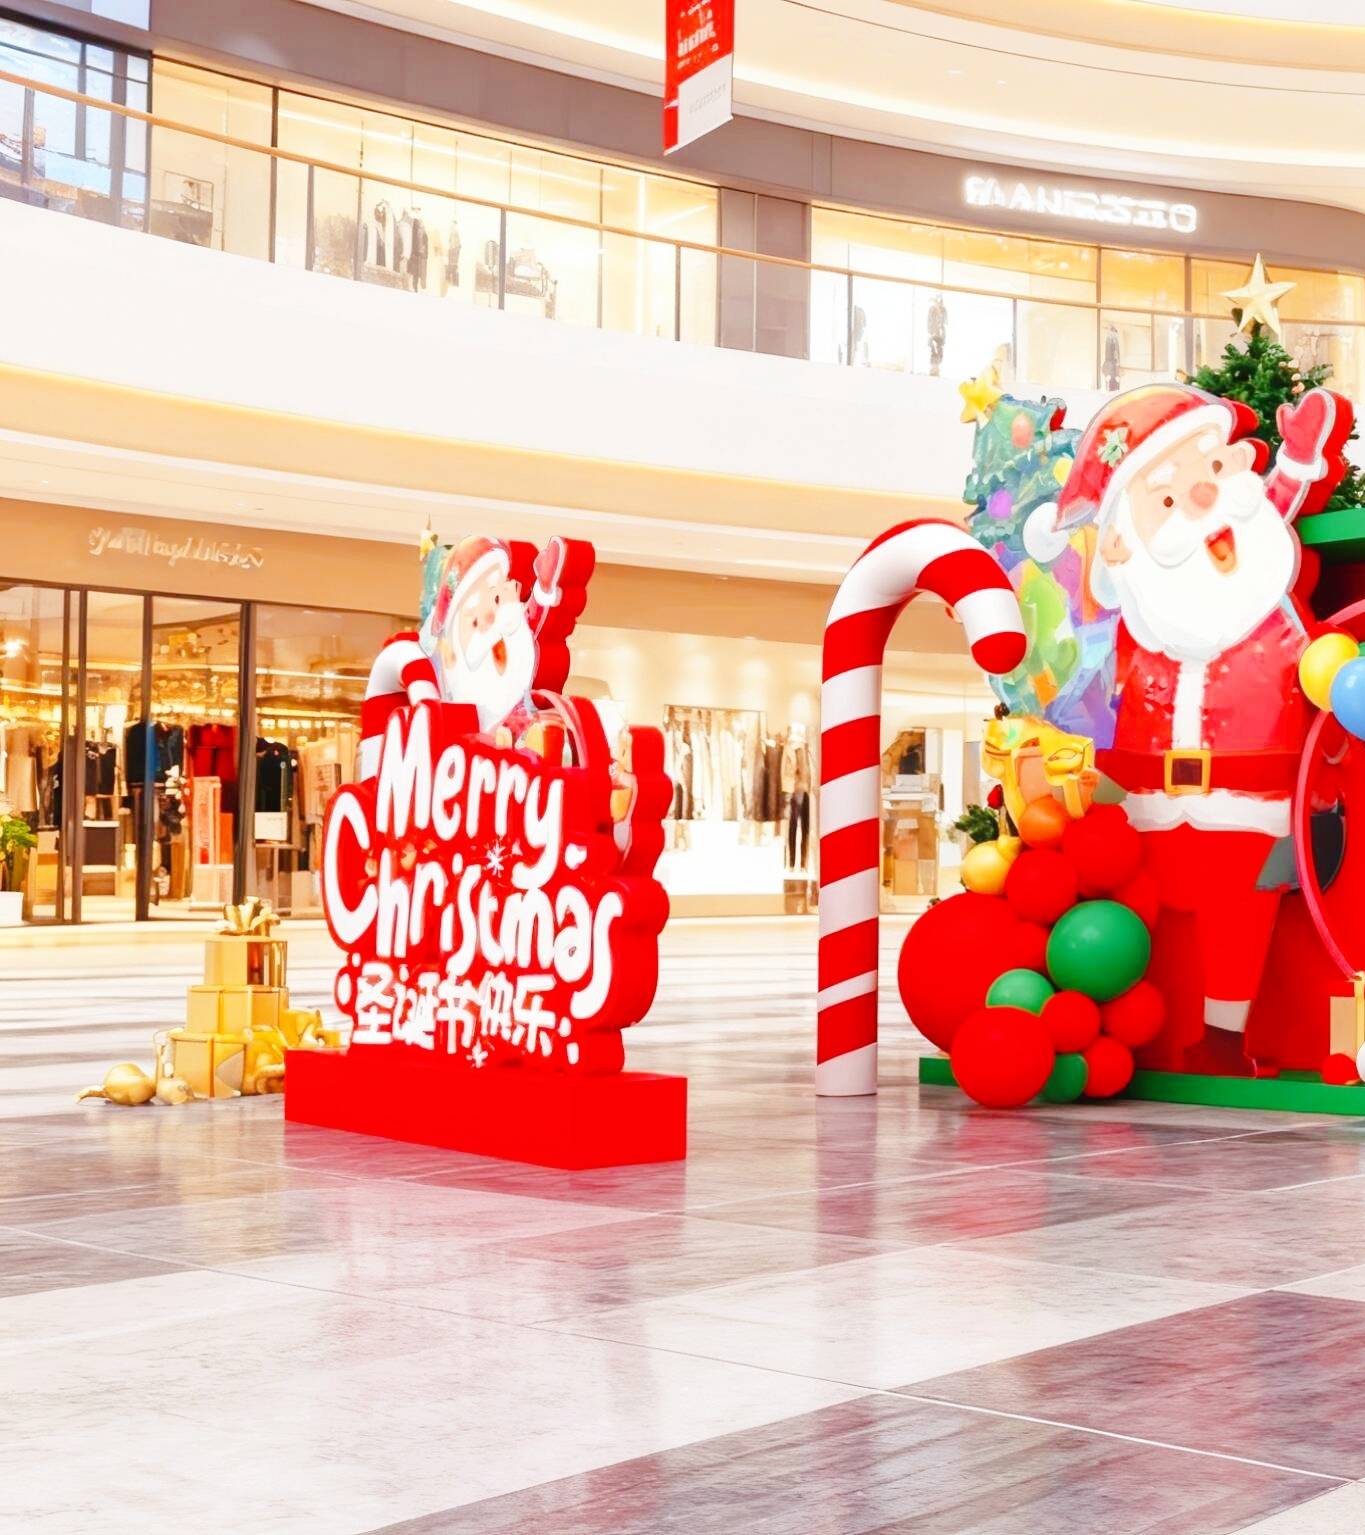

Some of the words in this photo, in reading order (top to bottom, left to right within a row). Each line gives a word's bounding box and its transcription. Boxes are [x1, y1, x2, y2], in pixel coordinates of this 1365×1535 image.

[376, 704, 564, 889] Merry
[325, 791, 623, 1019] Christmas
[352, 962, 556, 1057] 圣诞节快乐
